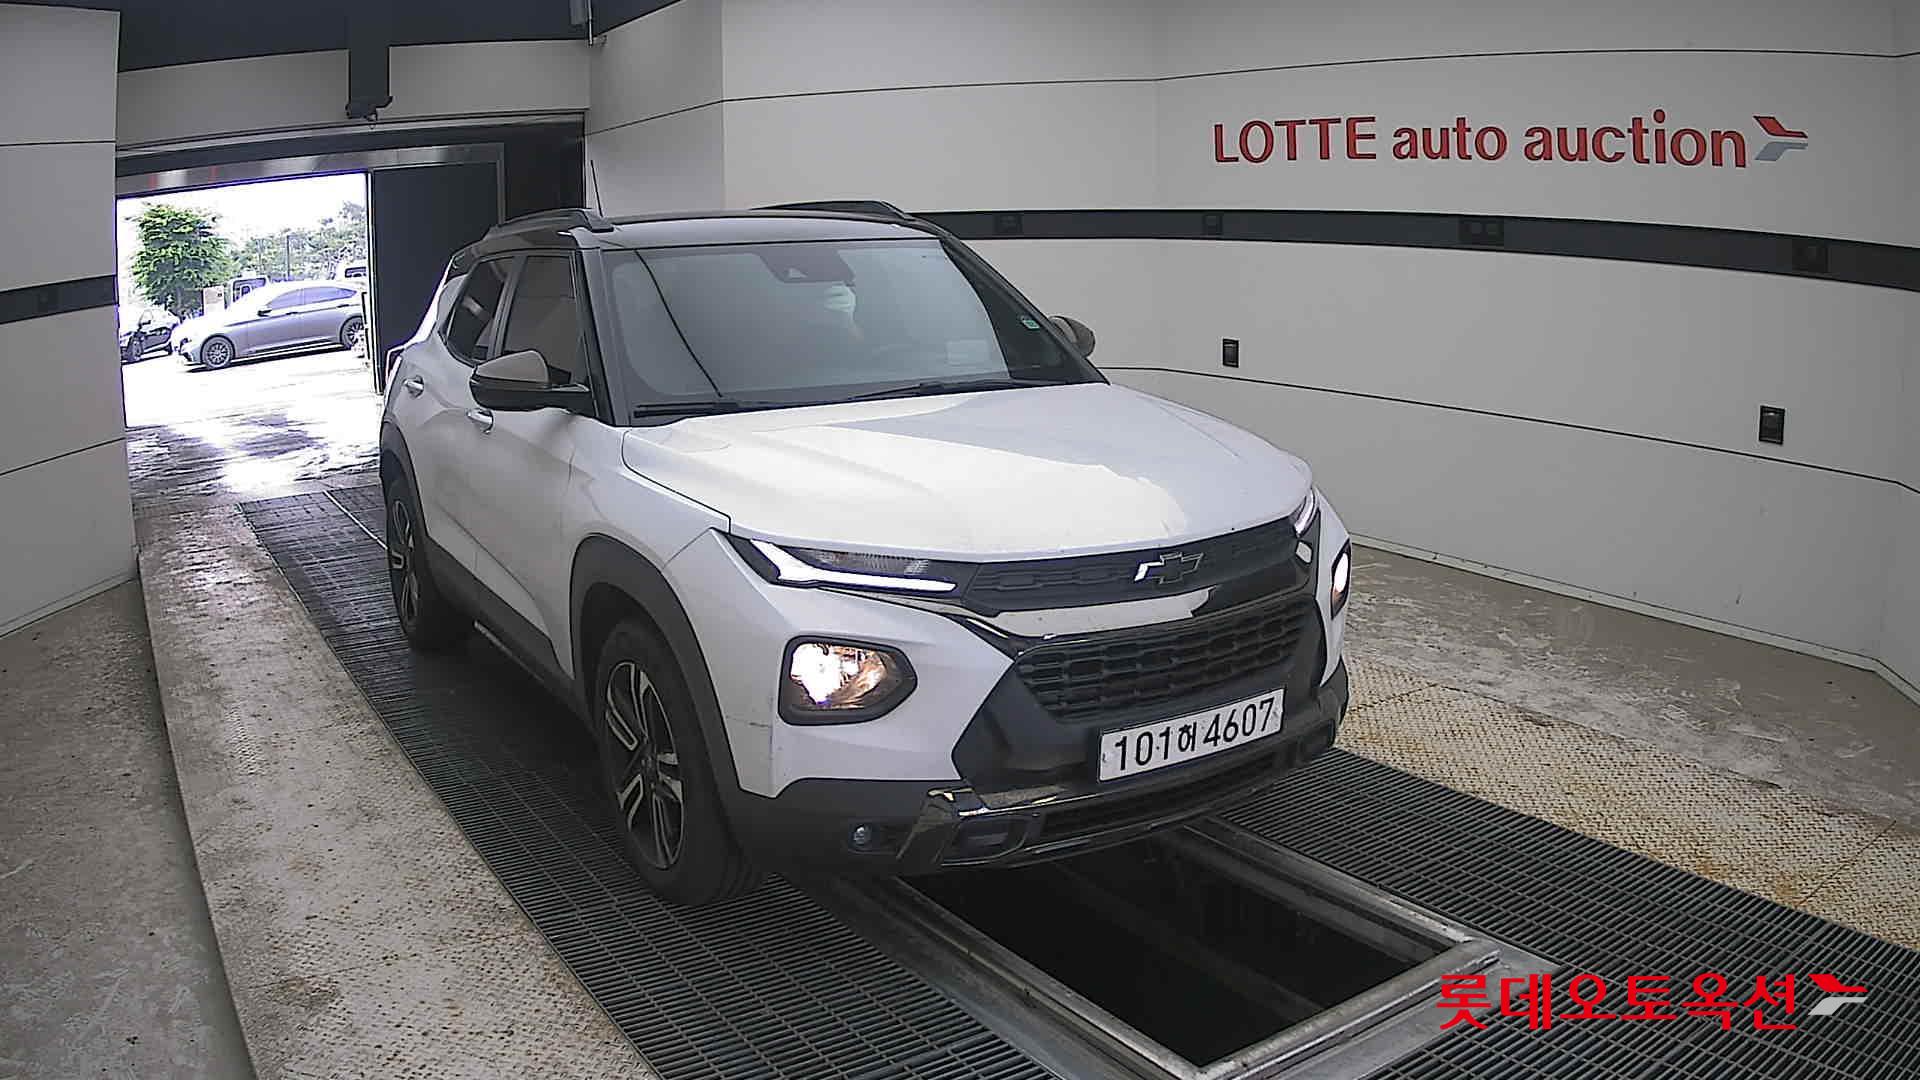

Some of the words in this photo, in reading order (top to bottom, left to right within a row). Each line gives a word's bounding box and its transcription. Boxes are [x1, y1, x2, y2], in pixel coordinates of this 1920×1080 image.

[1214, 116, 1376, 163] LOTTE
[1392, 116, 1508, 161] auto
[1523, 109, 1747, 168] auction
